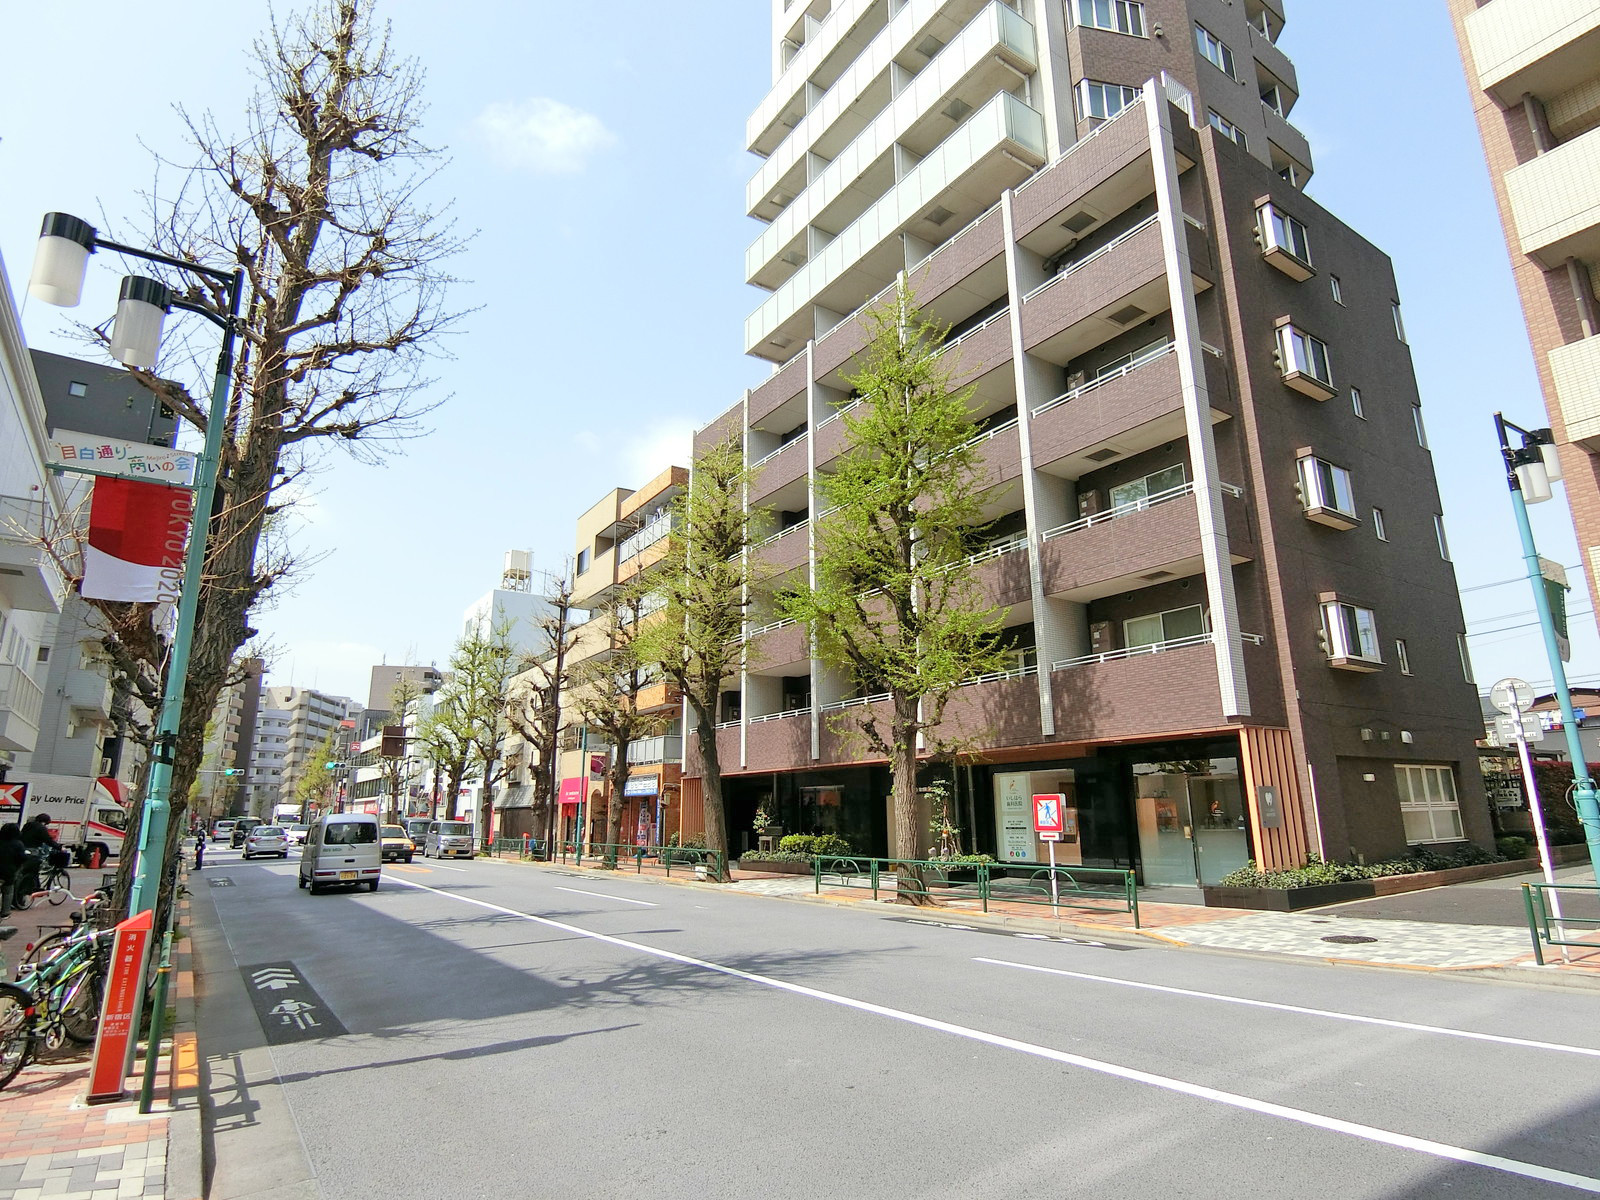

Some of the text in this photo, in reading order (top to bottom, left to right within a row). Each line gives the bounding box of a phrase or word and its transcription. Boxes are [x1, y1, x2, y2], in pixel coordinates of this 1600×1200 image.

[61, 444, 128, 460] 目白通り
[157, 488, 193, 604] TOKYO 2020
[30, 795, 85, 804] ay Low Price
